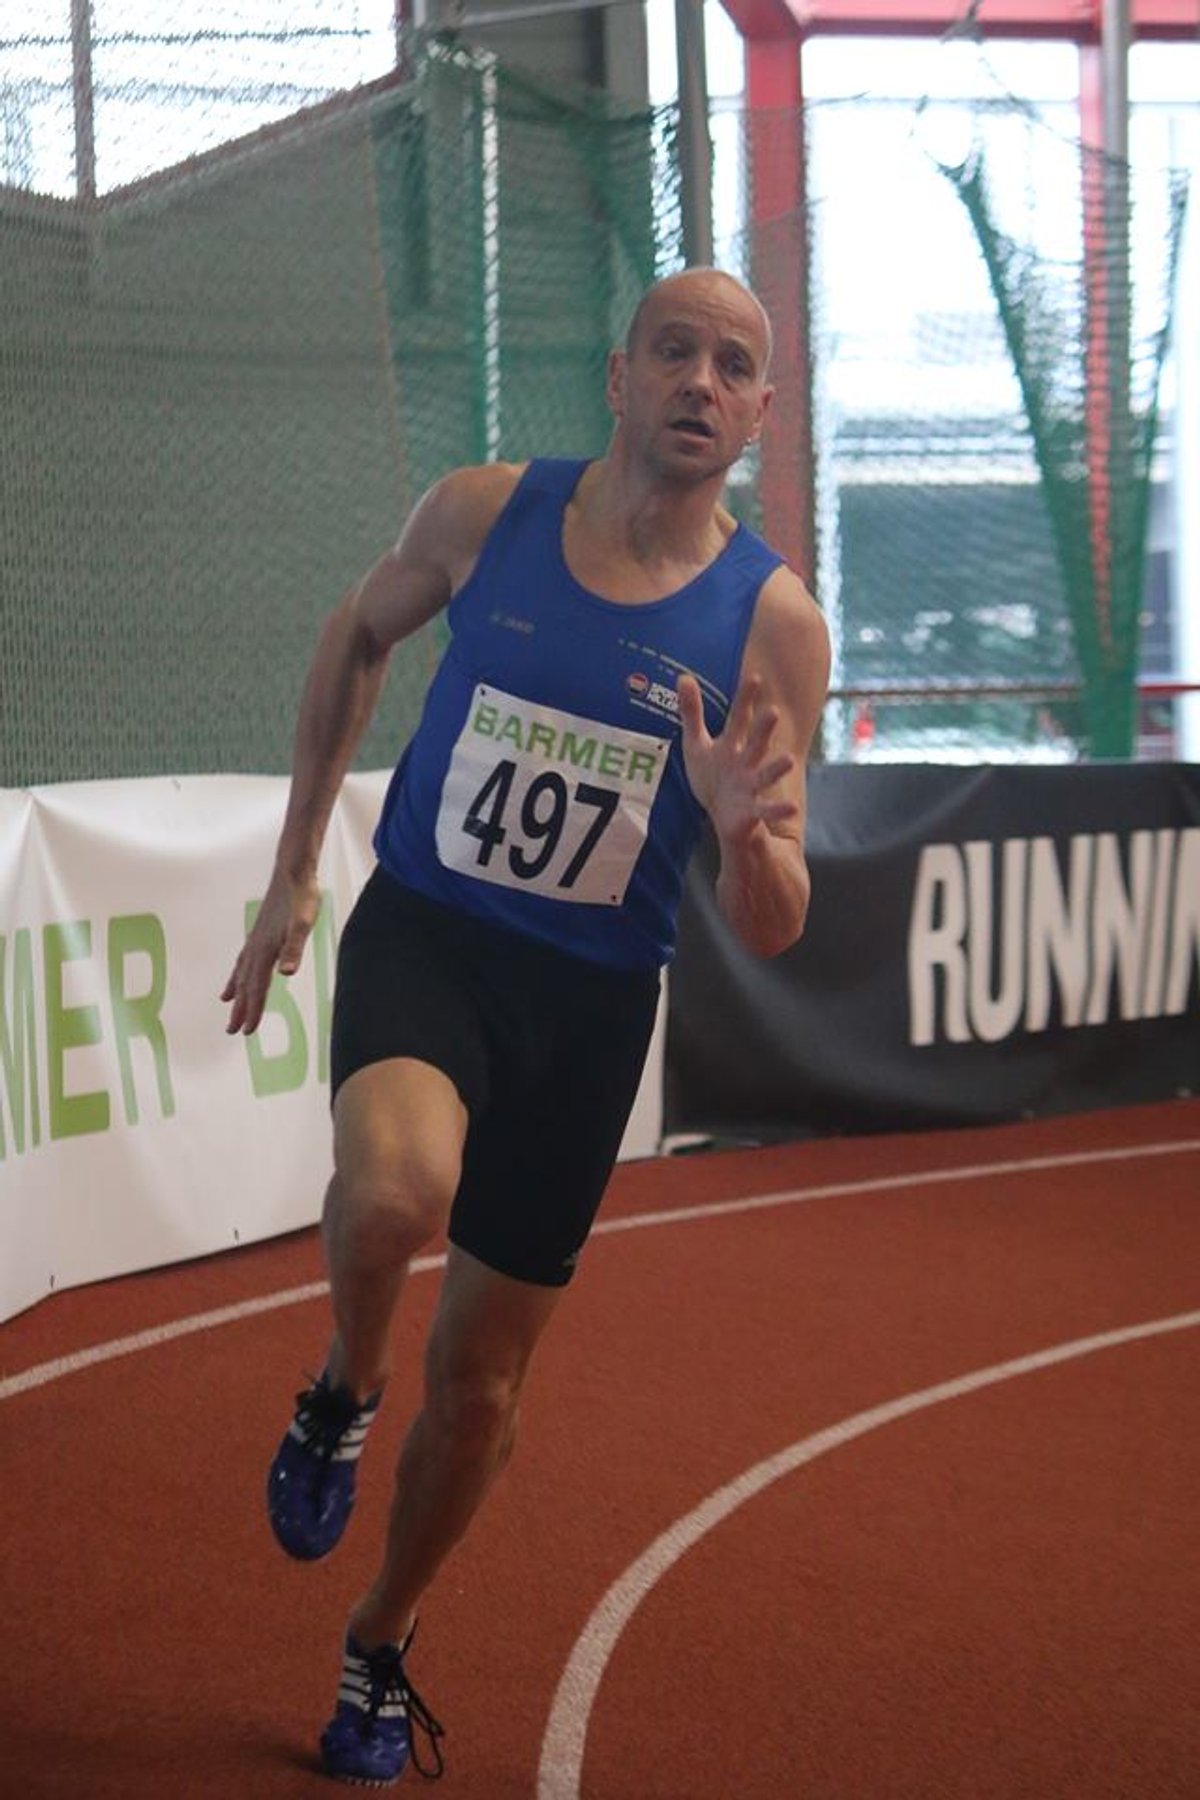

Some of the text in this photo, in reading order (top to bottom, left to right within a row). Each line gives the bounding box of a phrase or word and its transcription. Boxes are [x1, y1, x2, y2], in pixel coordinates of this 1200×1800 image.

[473, 704, 657, 783] BARMER
[462, 759, 621, 888] 497
[0, 912, 176, 1161] MER
